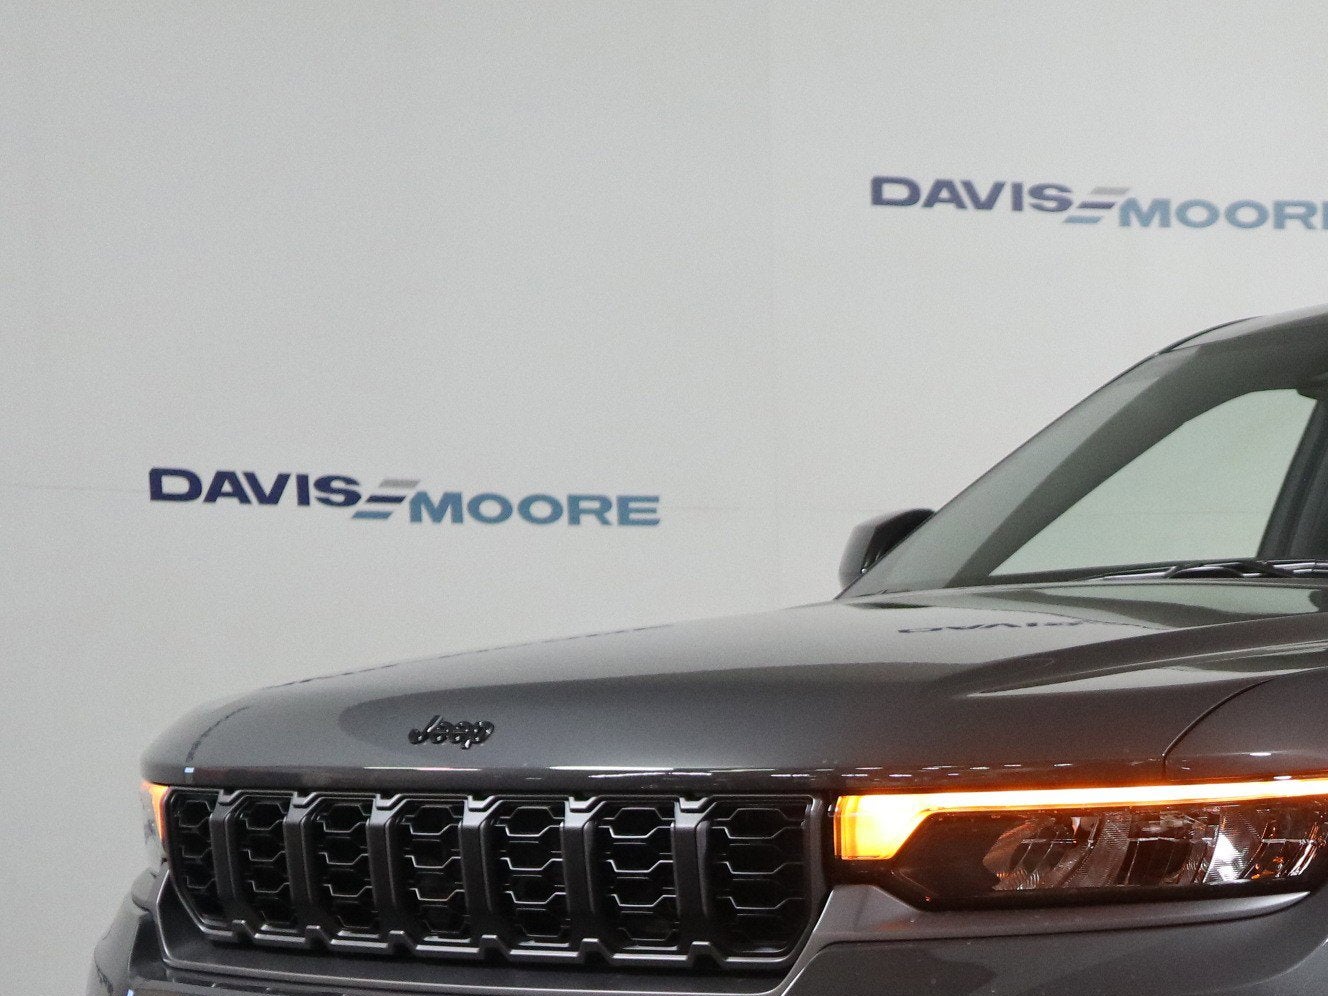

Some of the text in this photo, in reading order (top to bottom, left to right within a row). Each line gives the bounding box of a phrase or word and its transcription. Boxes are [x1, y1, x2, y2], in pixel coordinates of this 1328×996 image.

[870, 175, 1073, 213] DAVIS
[148, 467, 661, 527] DAVIS MOORE
[408, 714, 495, 750] Jeep
